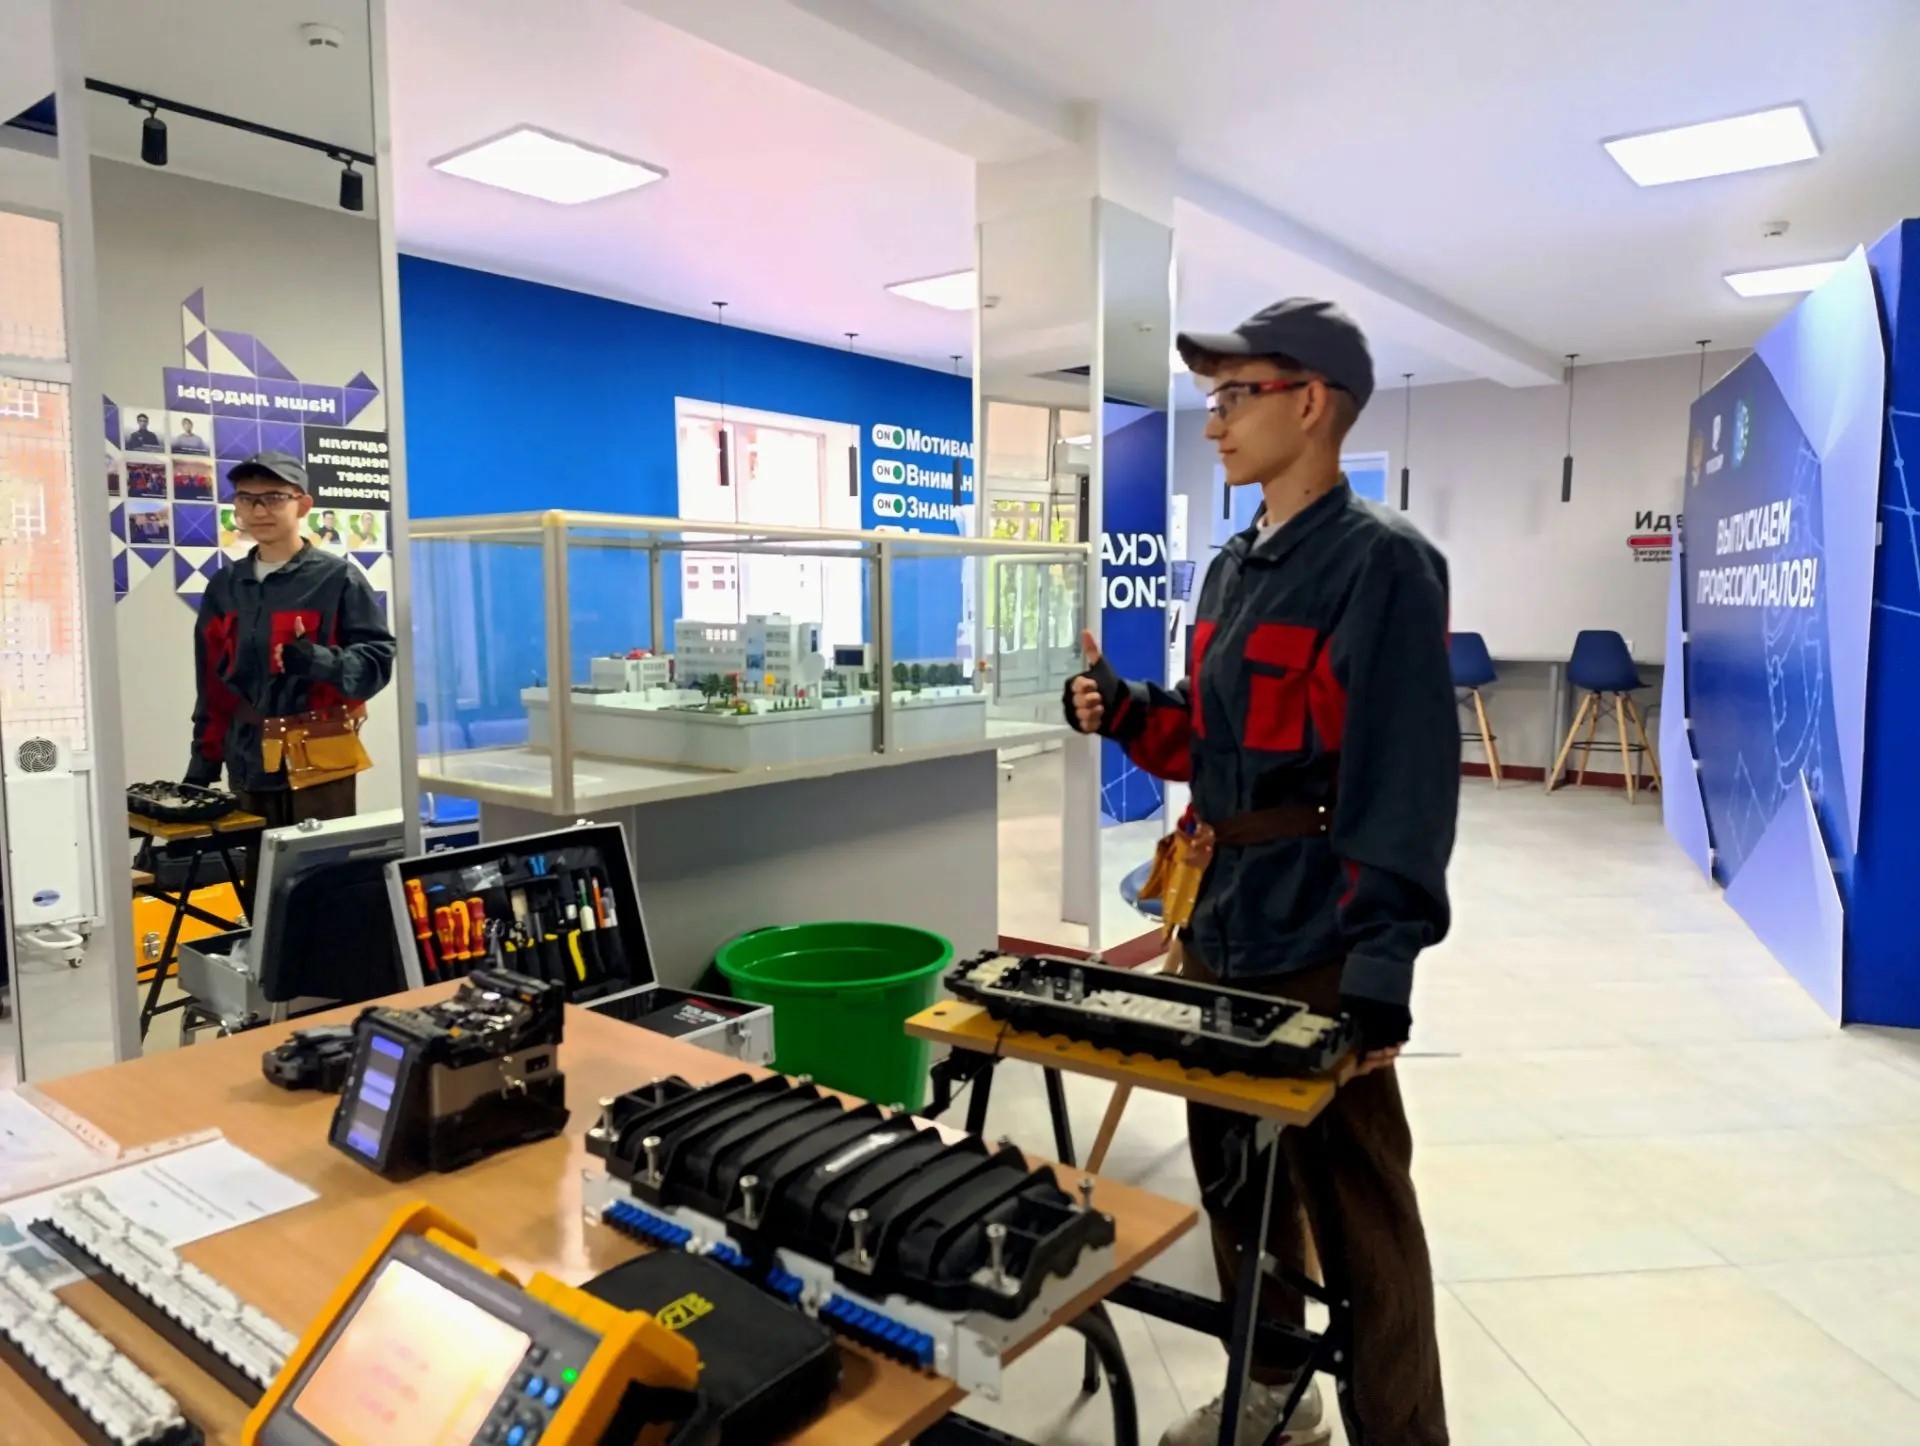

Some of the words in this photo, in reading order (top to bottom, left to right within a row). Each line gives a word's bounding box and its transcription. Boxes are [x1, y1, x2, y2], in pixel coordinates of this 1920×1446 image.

[876, 430, 891, 440] ON
[876, 465, 891, 475] ON
[877, 498, 892, 509] ON
[1716, 497, 1792, 555] ВЫПУСКАЕМ
[1697, 558, 1818, 607] ПРОФЕССИОНАЛОВ!
